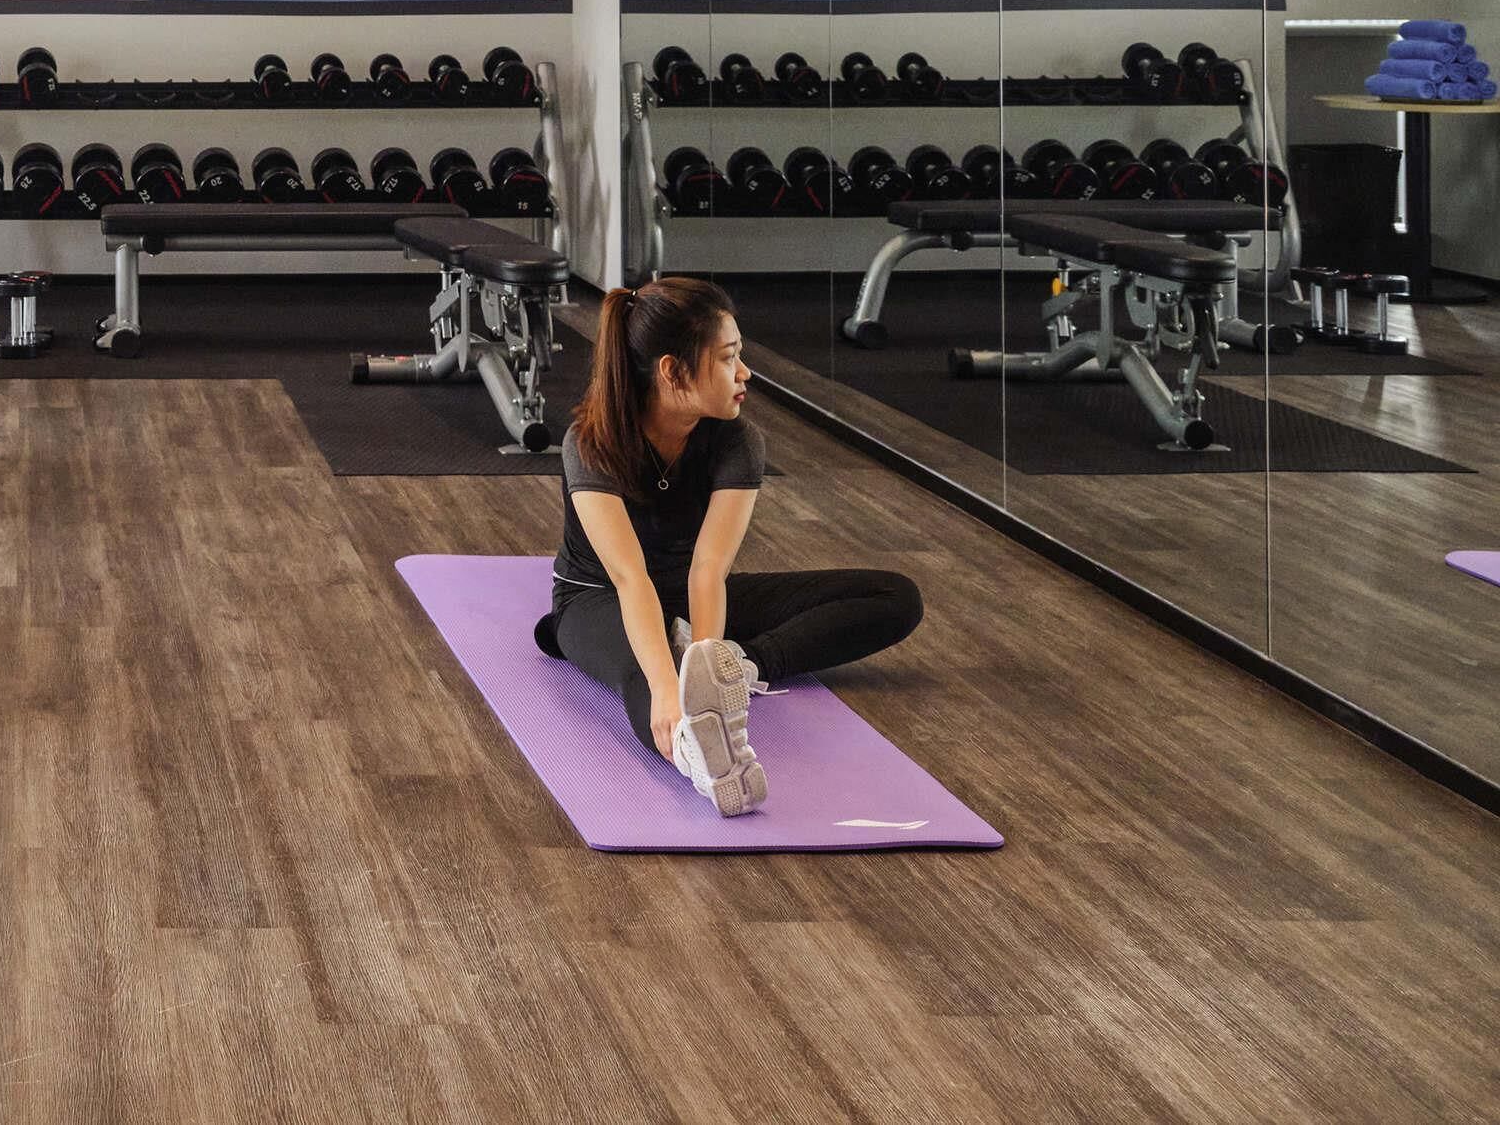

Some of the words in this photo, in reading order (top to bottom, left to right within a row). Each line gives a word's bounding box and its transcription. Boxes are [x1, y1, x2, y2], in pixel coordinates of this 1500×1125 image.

[20, 176, 33, 189] 25
[210, 177, 223, 187] 20
[78, 193, 97, 211] 22.5
[139, 189, 154, 203] 22.
